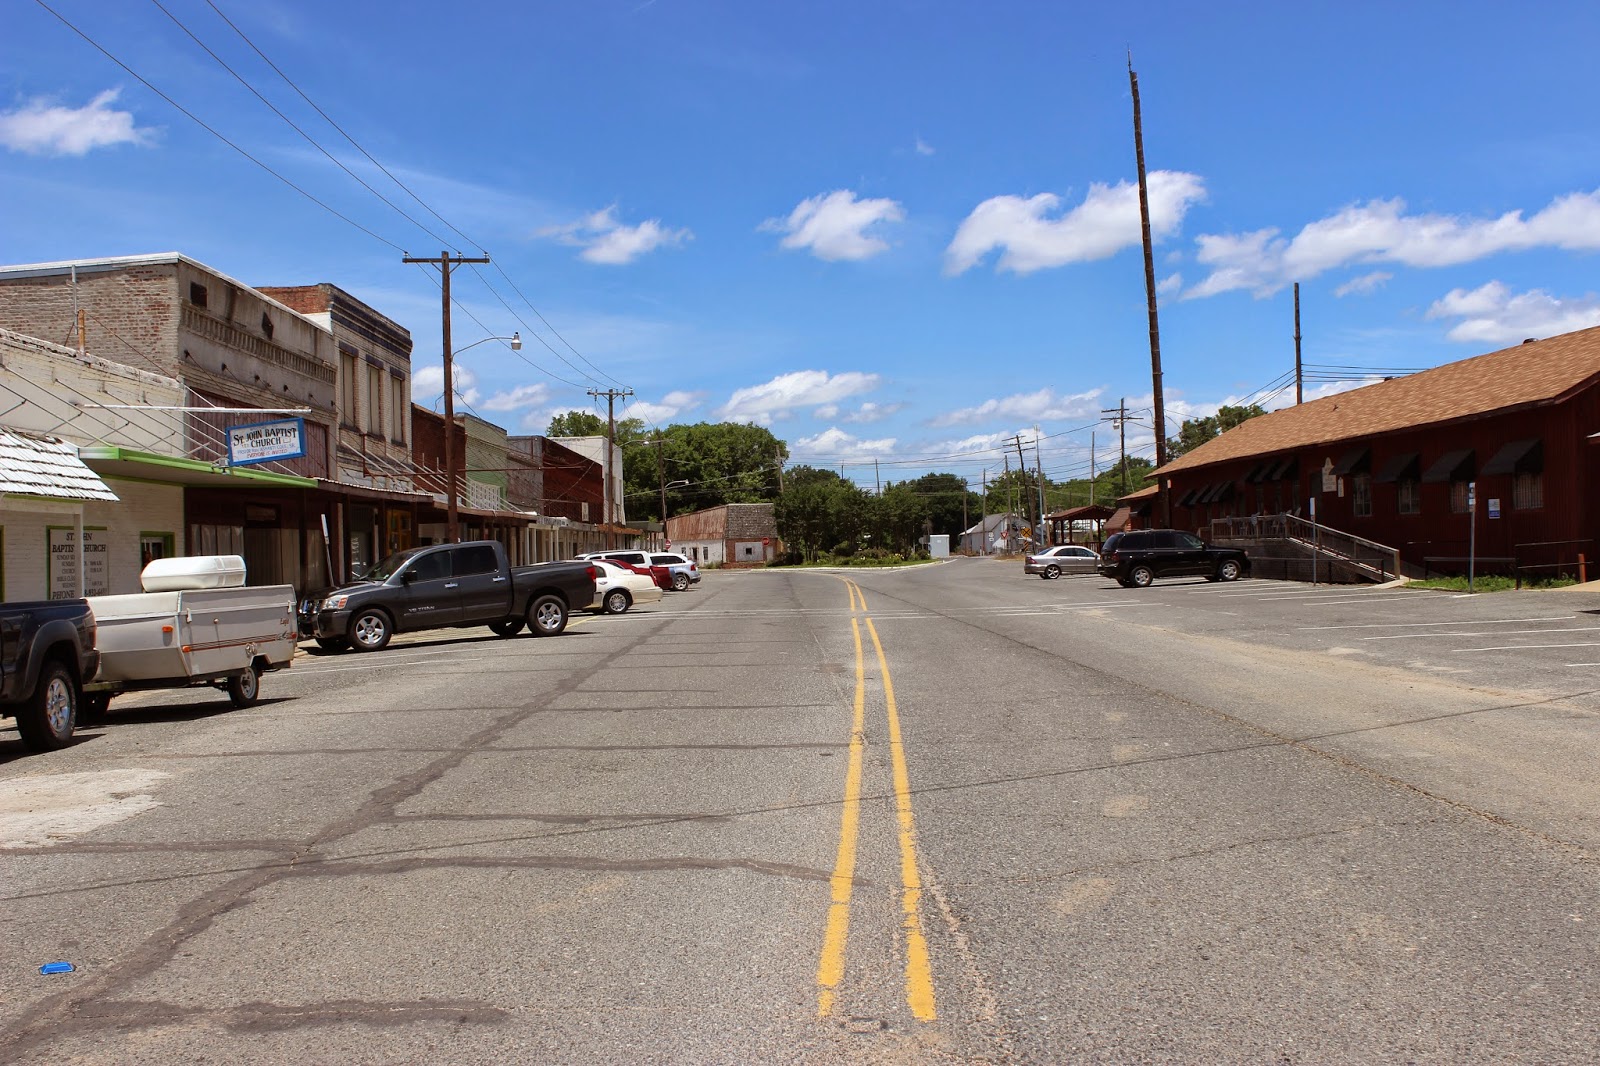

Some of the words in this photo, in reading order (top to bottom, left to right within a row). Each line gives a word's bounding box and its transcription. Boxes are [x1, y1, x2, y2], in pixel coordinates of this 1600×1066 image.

[246, 429, 263, 442] JOHN
[264, 427, 297, 438] BAPTIST
[250, 436, 281, 448] CHURCH
[52, 544, 75, 553] BAPTIS
[83, 544, 107, 553] HURCH
[52, 590, 75, 600] PHONE
